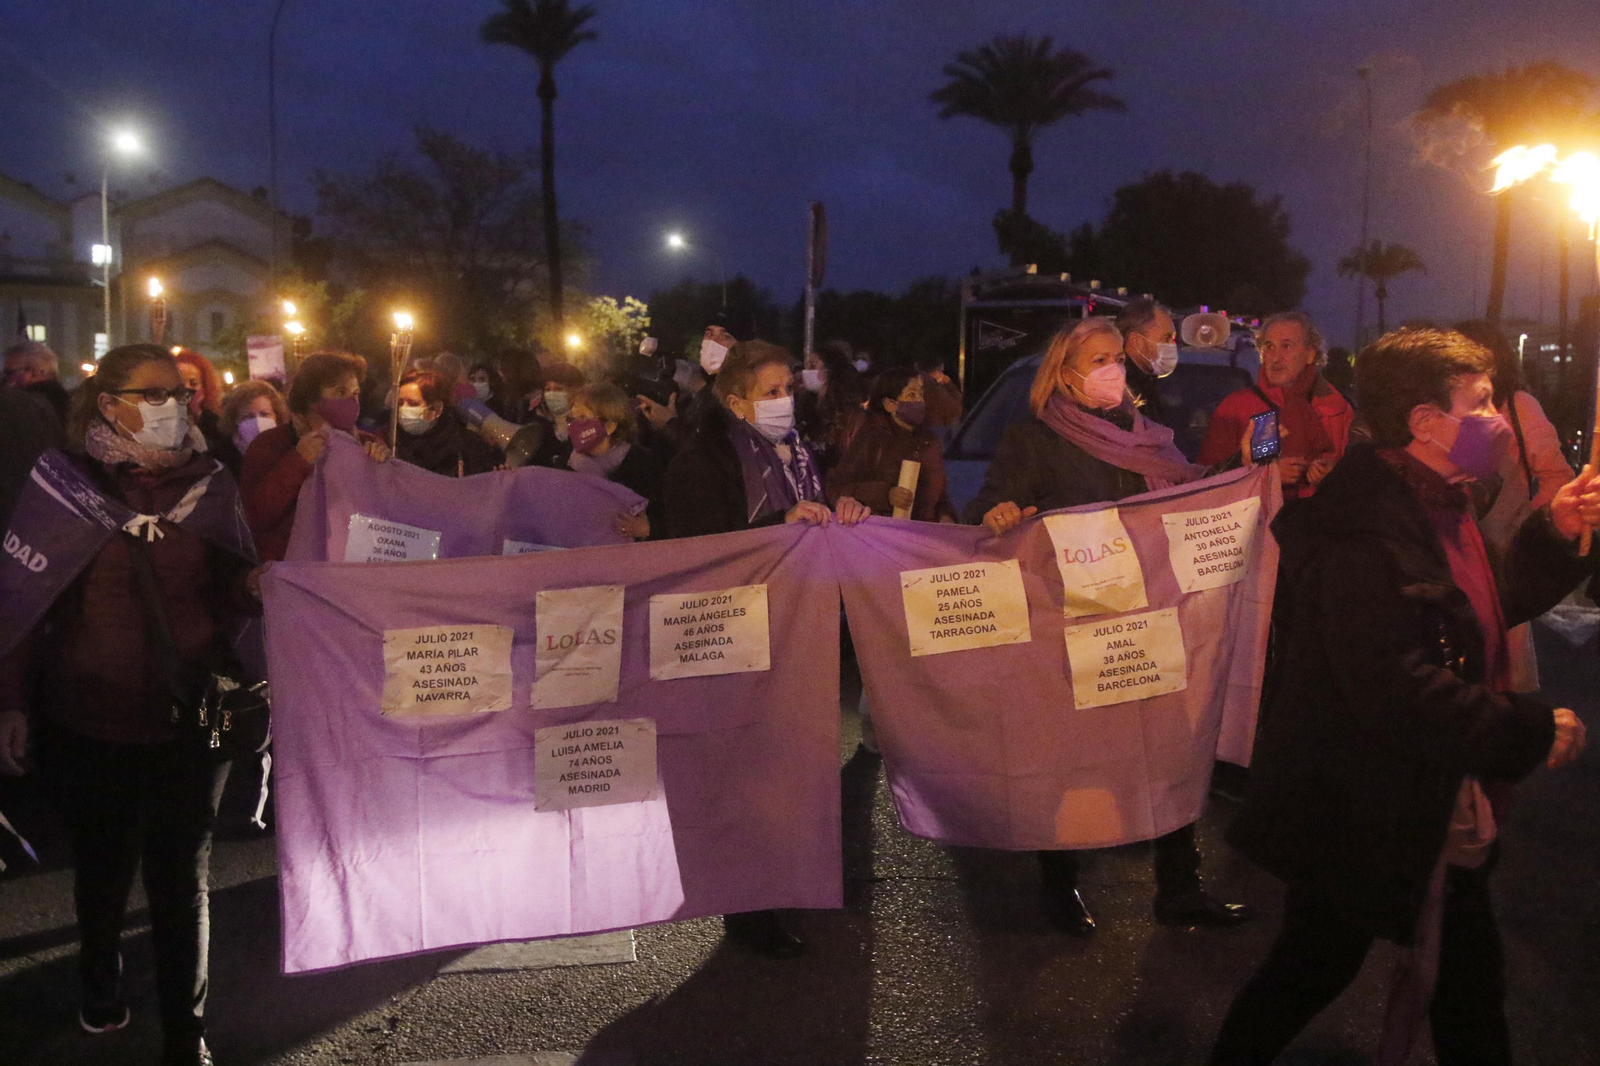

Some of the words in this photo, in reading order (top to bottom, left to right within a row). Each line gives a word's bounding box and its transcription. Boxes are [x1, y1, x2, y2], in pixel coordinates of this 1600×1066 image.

[1185, 516, 1209, 526] JULIO
[1211, 511, 1232, 522] 2021
[367, 523, 403, 536] AGOSTO
[403, 529, 420, 539] 2021
[1184, 521, 1242, 541] ANTONELLA
[377, 536, 406, 548] OXANA
[1195, 543, 1207, 551] 30
[1209, 535, 1236, 548] AÑOS
[384, 547, 407, 559] AÑOS
[1063, 537, 1127, 564] LOLAS
[1193, 547, 1243, 564] ASESINADA
[930, 572, 961, 584] JULIO
[963, 569, 986, 580] 2021
[936, 585, 980, 598] PAMELA
[679, 598, 709, 610] JULIO
[711, 595, 732, 605] 2021
[938, 602, 950, 612] 25
[952, 598, 983, 610] AÑOS
[663, 614, 697, 626] MARÍA
[699, 607, 747, 622] ÁNGELES
[934, 610, 995, 626] ASESINADA
[683, 628, 694, 637] 46
[696, 623, 725, 635] AÑOS
[930, 623, 997, 639] TARRAGONA
[1093, 624, 1124, 637] JULIO
[1126, 620, 1148, 632] 2021
[415, 633, 448, 645] JULIO
[450, 631, 474, 642] 2021
[546, 628, 616, 651] LOLAS
[674, 636, 734, 652] ASESINADA
[1106, 638, 1136, 651] AMAL
[407, 649, 445, 661] MARÍA
[448, 647, 479, 659] PILAR
[680, 651, 725, 664] MÁLAGA
[1103, 655, 1115, 665] 38
[1117, 649, 1146, 663] AÑOS
[419, 665, 432, 674] 43
[435, 662, 466, 674] AÑOS
[1098, 661, 1157, 678] ASESINADA
[412, 676, 479, 689] ASESINADA
[1097, 673, 1161, 692] BARCELONA
[416, 691, 471, 703] NAVARRA
[563, 728, 594, 740] JULIO
[596, 726, 619, 736] 2021
[551, 745, 582, 758] LUISA
[583, 741, 624, 752] AMELIA
[568, 760, 580, 768] 74
[581, 755, 613, 766] AÑOS
[559, 768, 621, 783] ASESINADA
[568, 783, 611, 795] MADRID
